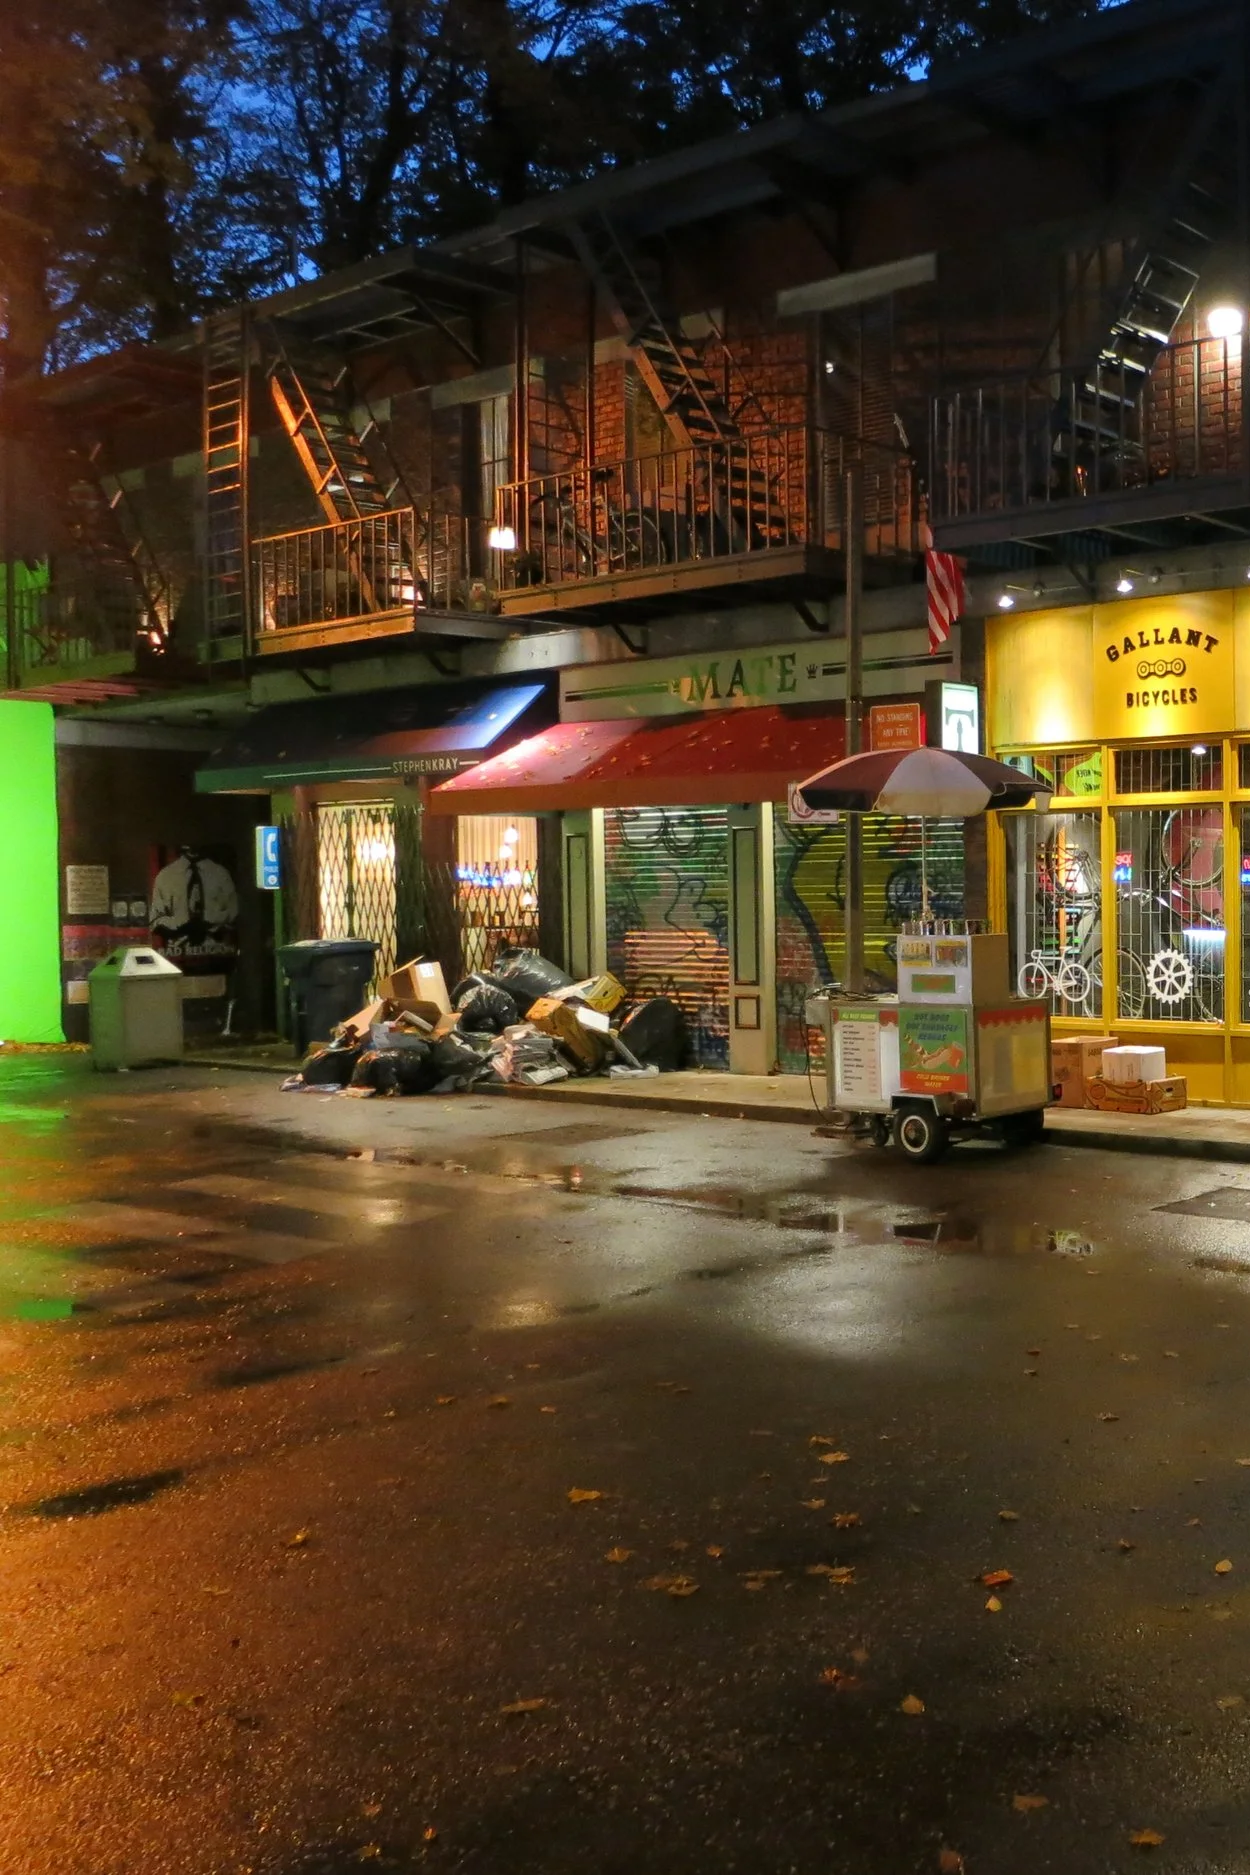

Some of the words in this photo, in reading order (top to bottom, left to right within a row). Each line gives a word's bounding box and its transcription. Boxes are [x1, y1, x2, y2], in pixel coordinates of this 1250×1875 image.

[1106, 627, 1218, 662] GALLANT
[687, 653, 797, 702] MATE
[1126, 688, 1198, 708] BICYCLES
